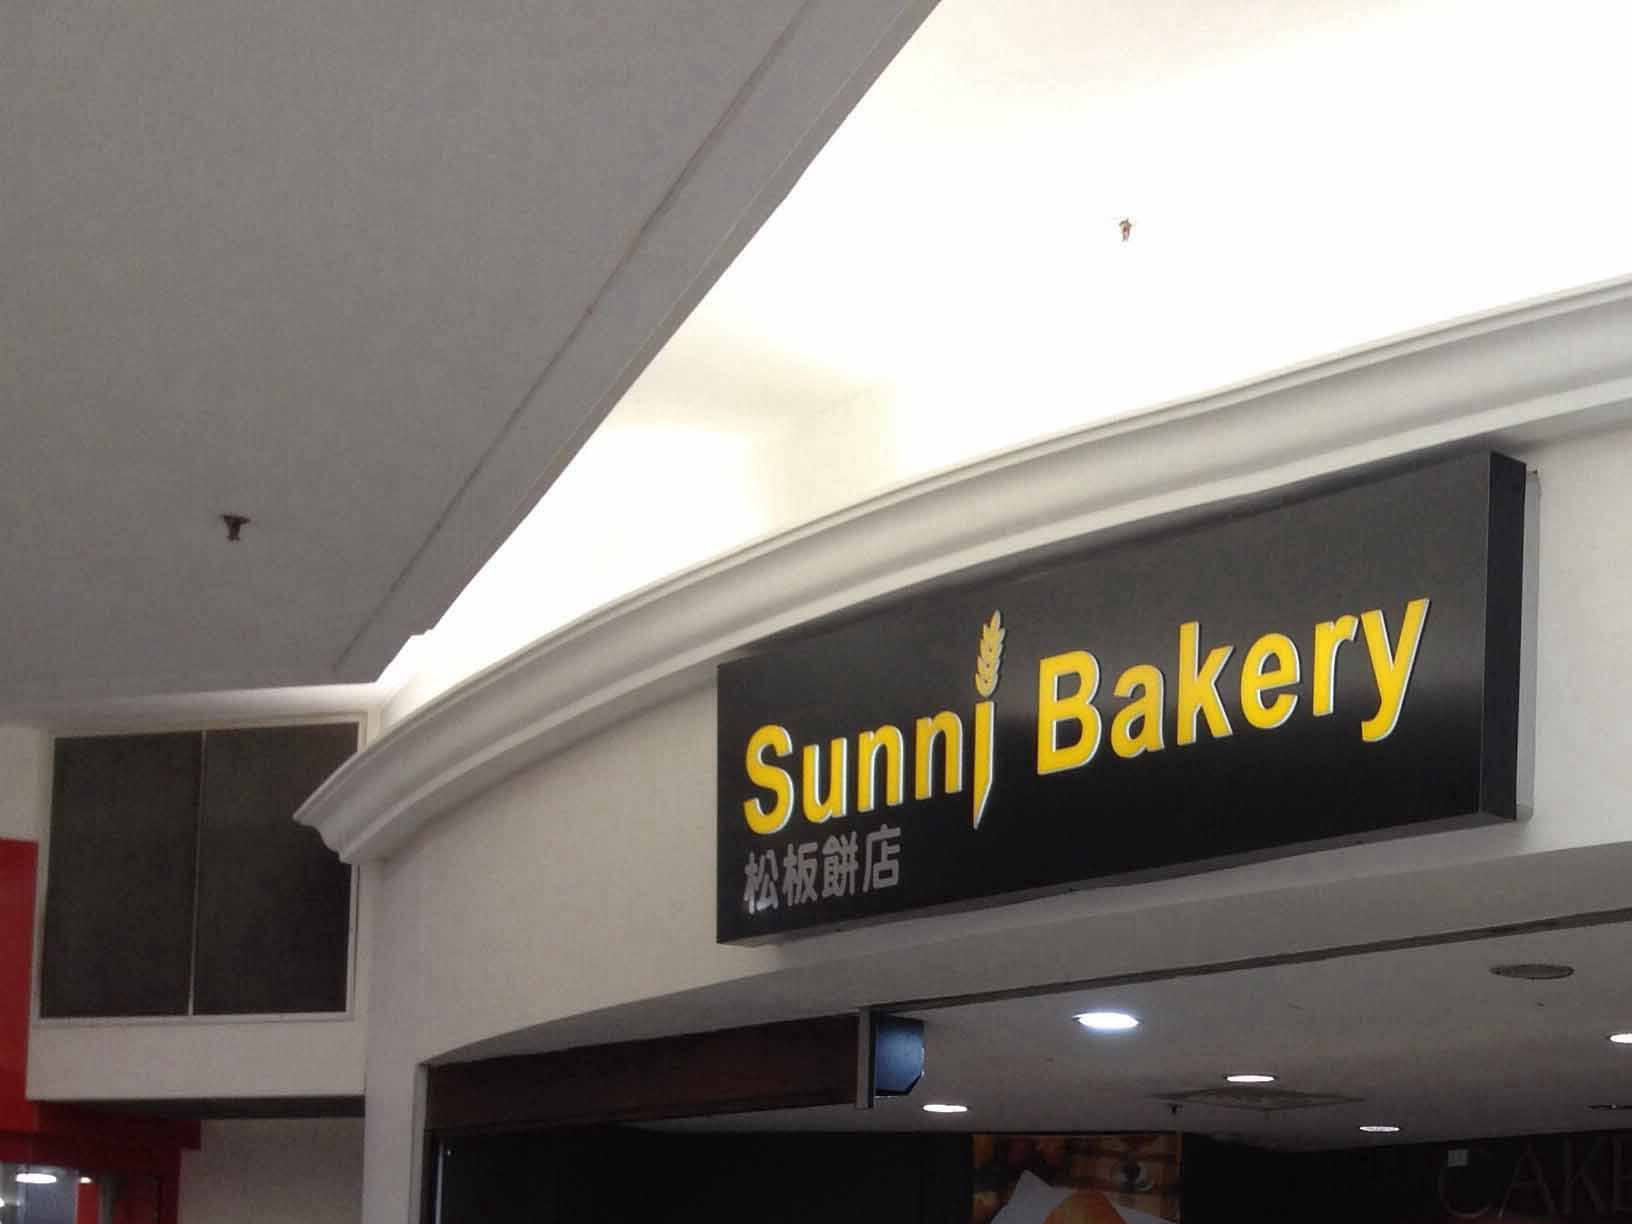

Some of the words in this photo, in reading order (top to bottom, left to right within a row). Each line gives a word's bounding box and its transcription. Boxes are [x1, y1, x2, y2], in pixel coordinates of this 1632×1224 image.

[742, 612, 1006, 834] Sunni
[1036, 598, 1431, 776] Bakery
[742, 822, 901, 914] 松板餅店
